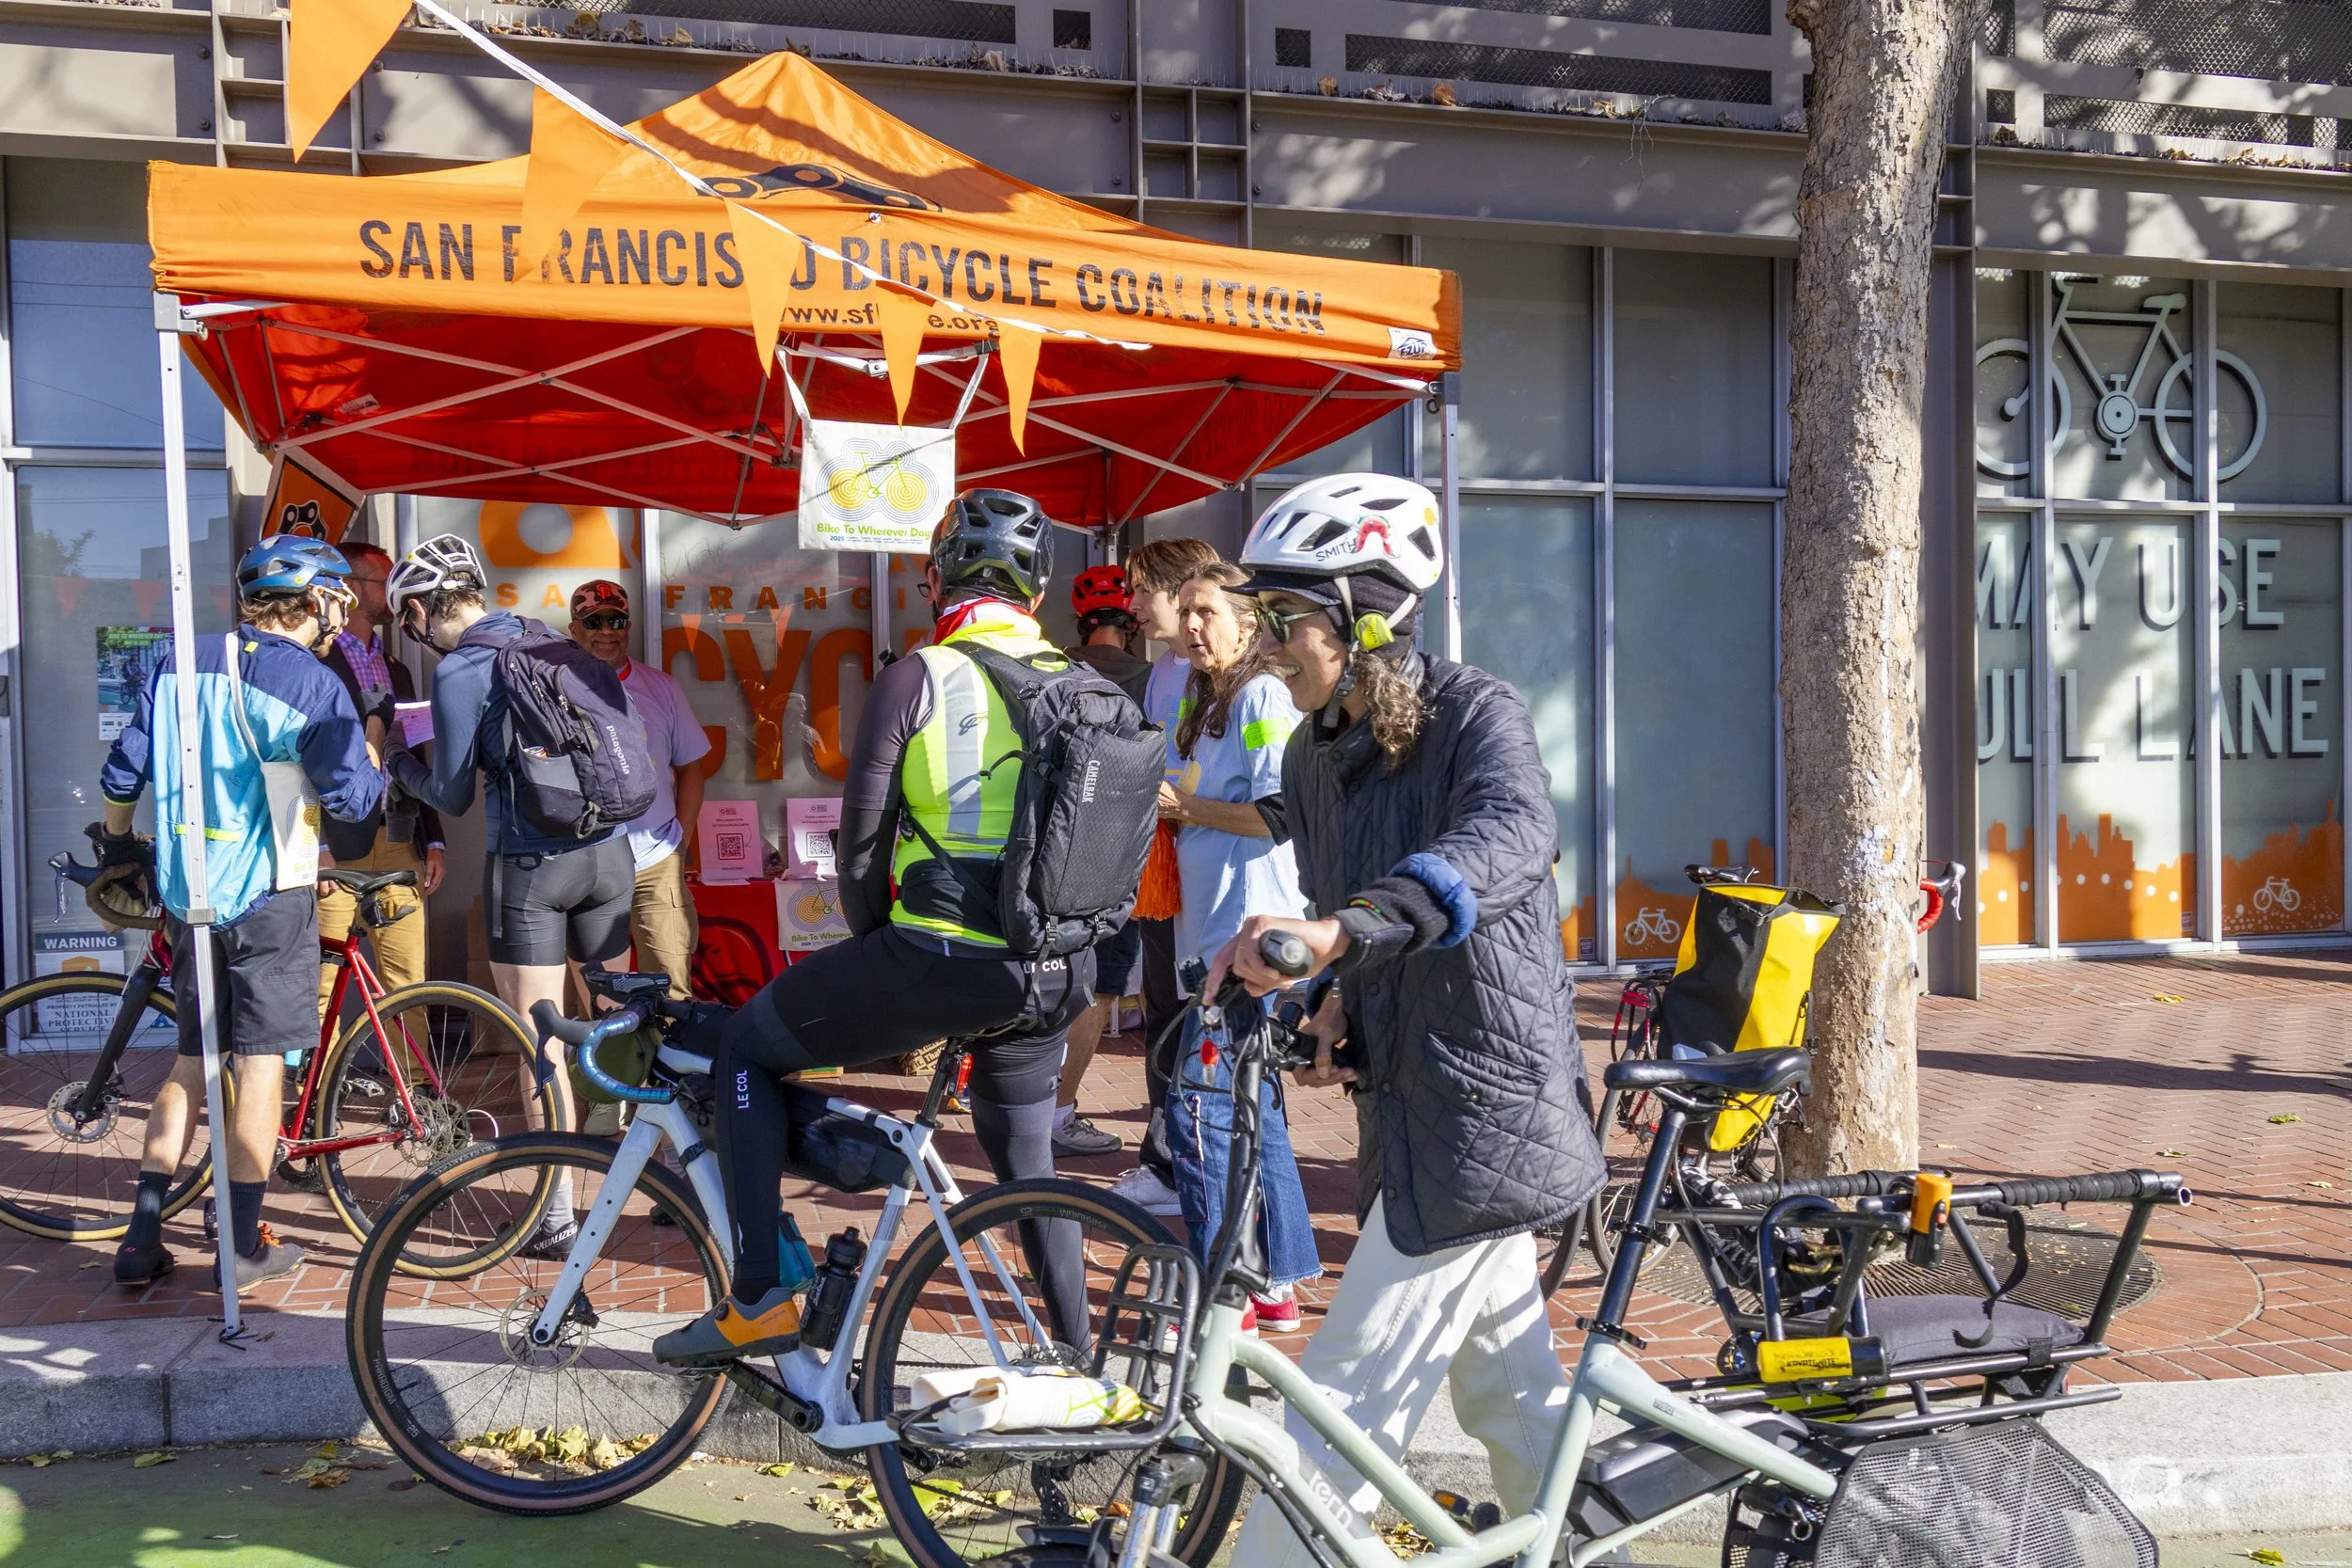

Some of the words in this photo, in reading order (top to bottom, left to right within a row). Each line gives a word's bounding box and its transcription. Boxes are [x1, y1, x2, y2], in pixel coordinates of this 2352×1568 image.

[359, 219, 474, 281] SAN
[501, 224, 817, 291] FRANCISO
[840, 235, 1057, 309] BICYCLE
[1075, 262, 1326, 336] COALITION
[780, 301, 1001, 340] ww.sfe.org
[817, 522, 840, 533] Bike
[843, 524, 855, 534] To
[857, 525, 908, 537] Wherever
[1315, 537, 1357, 562] SMITH
[496, 583, 565, 608] SA
[665, 585, 906, 610] FRANCI
[1977, 668, 2106, 759] ULL
[605, 725, 630, 775] patagonia
[1082, 759, 1101, 803] CAMELBAK
[44, 936, 118, 949] WARNING
[1041, 958, 1067, 972] COL
[55, 1009, 112, 1018] NATIONAL
[737, 1069, 748, 1092] COL
[738, 1093, 750, 1109] LE
